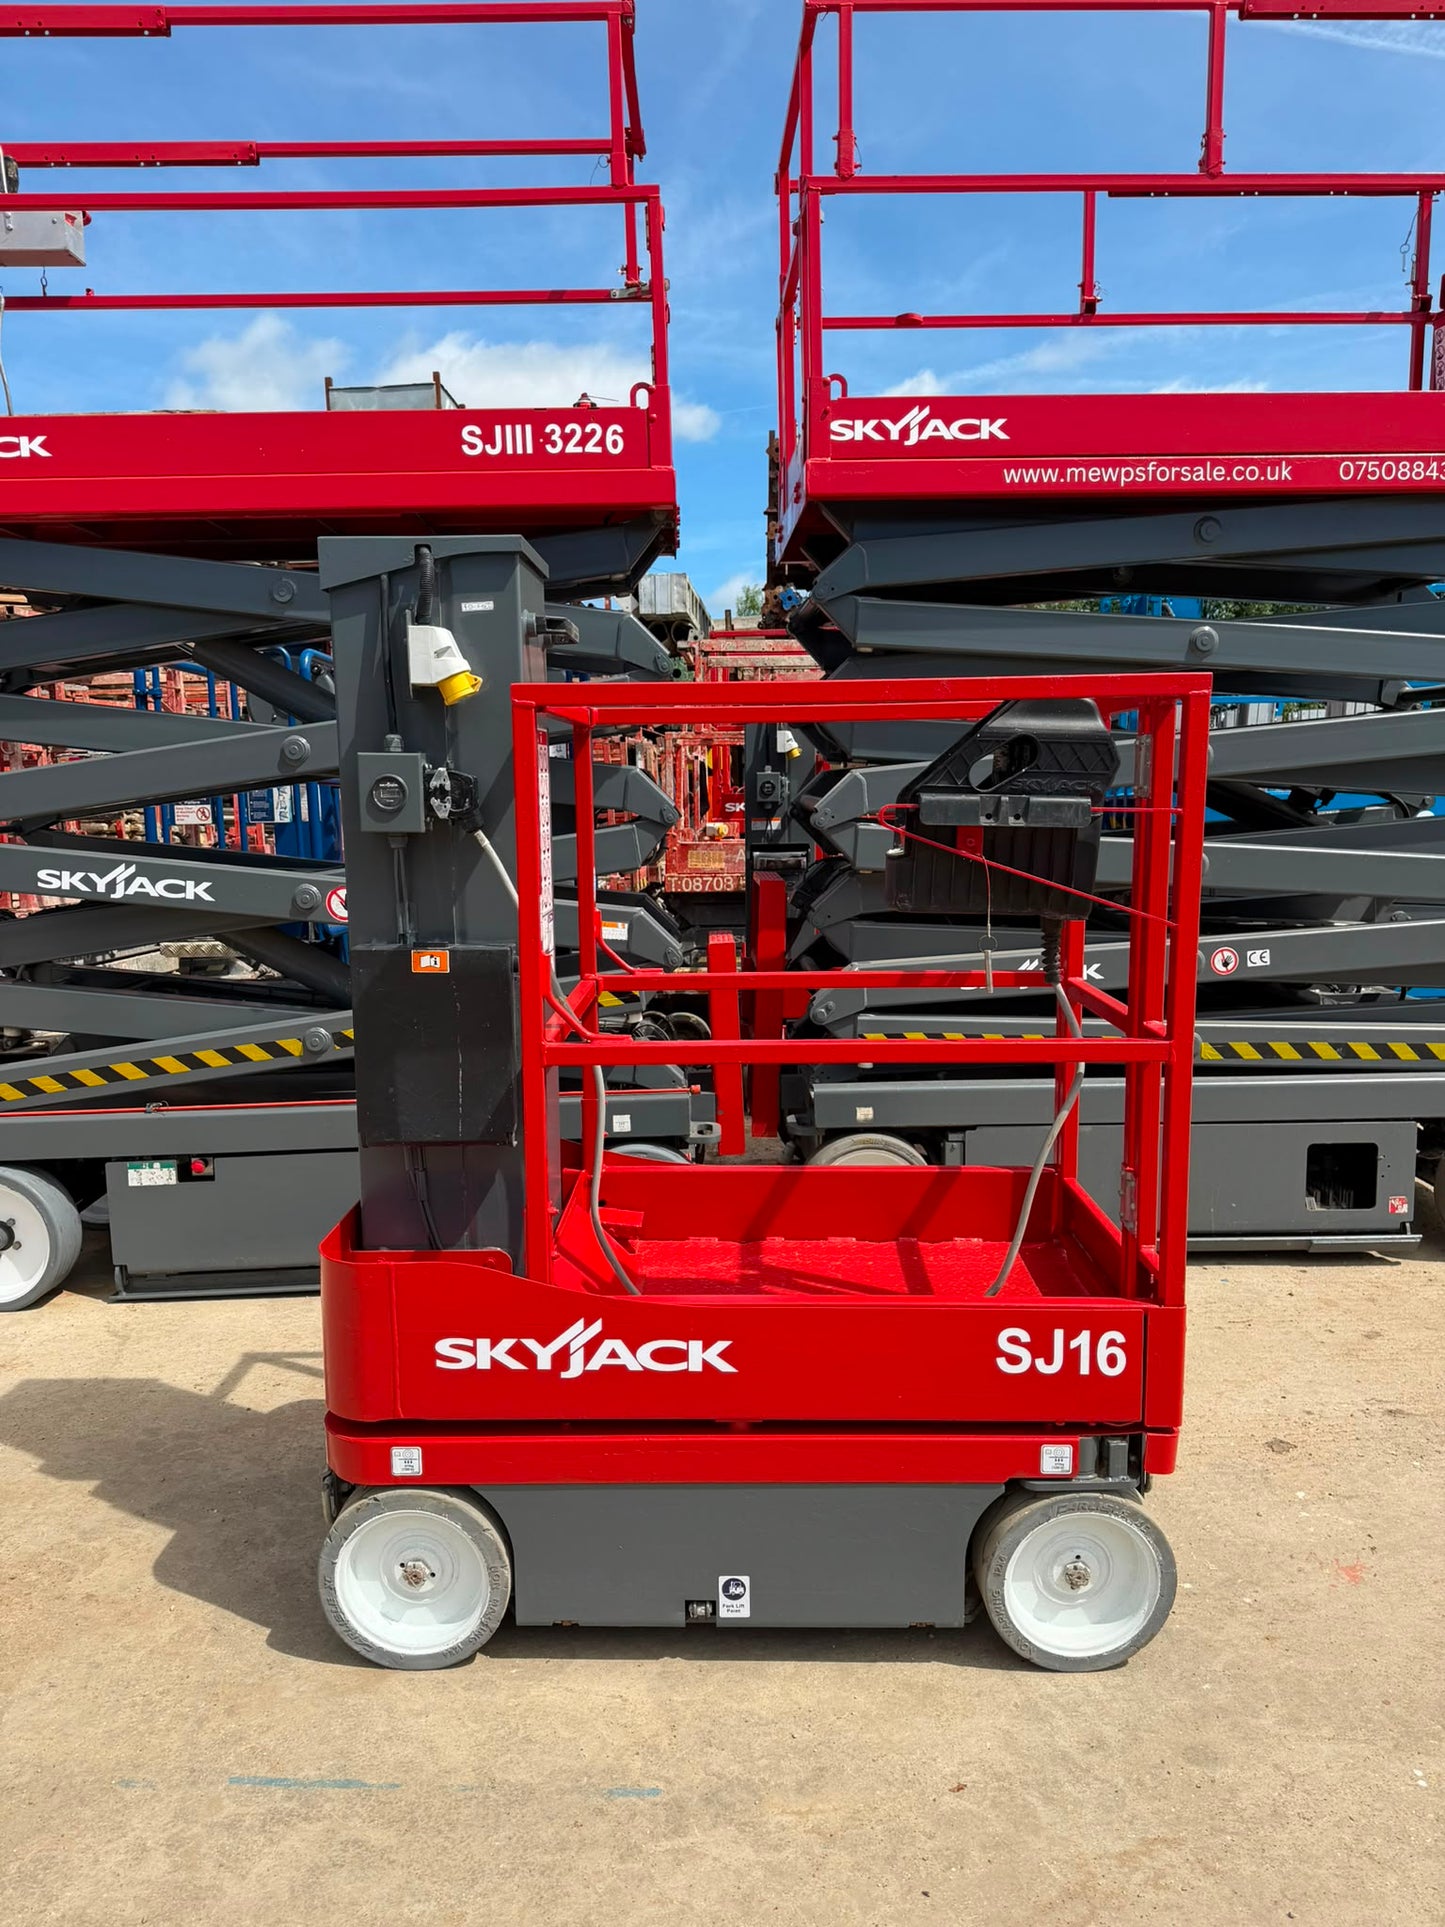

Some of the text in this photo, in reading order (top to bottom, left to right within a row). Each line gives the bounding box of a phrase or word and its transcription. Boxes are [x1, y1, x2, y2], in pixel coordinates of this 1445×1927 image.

[461, 423, 624, 456] SJIII 3226
[829, 405, 1011, 446] SKYJACK
[1003, 461, 1293, 487] www.mewpsforsale.co.uk
[36, 863, 216, 902] SKYJACK
[434, 1317, 1127, 1379] SKYJACK SJ16
